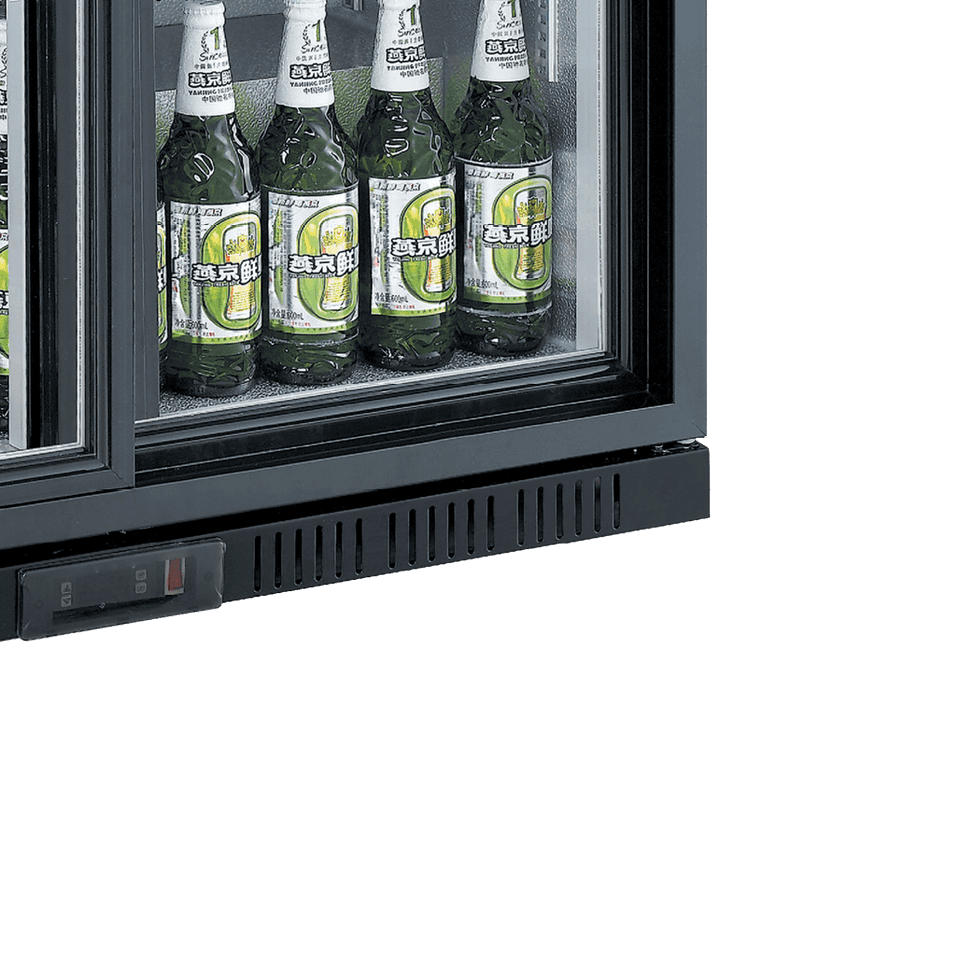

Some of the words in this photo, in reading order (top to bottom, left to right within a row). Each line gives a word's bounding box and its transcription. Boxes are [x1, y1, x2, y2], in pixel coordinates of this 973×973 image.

[407, 4, 416, 25] 1
[210, 27, 219, 50] 1
[312, 19, 320, 42] 1
[391, 228, 456, 259] 燕京鲜
[482, 215, 553, 247] 燕京鲜
[191, 253, 262, 285] 燕京鲜
[287, 243, 359, 277] 燕京鲜
